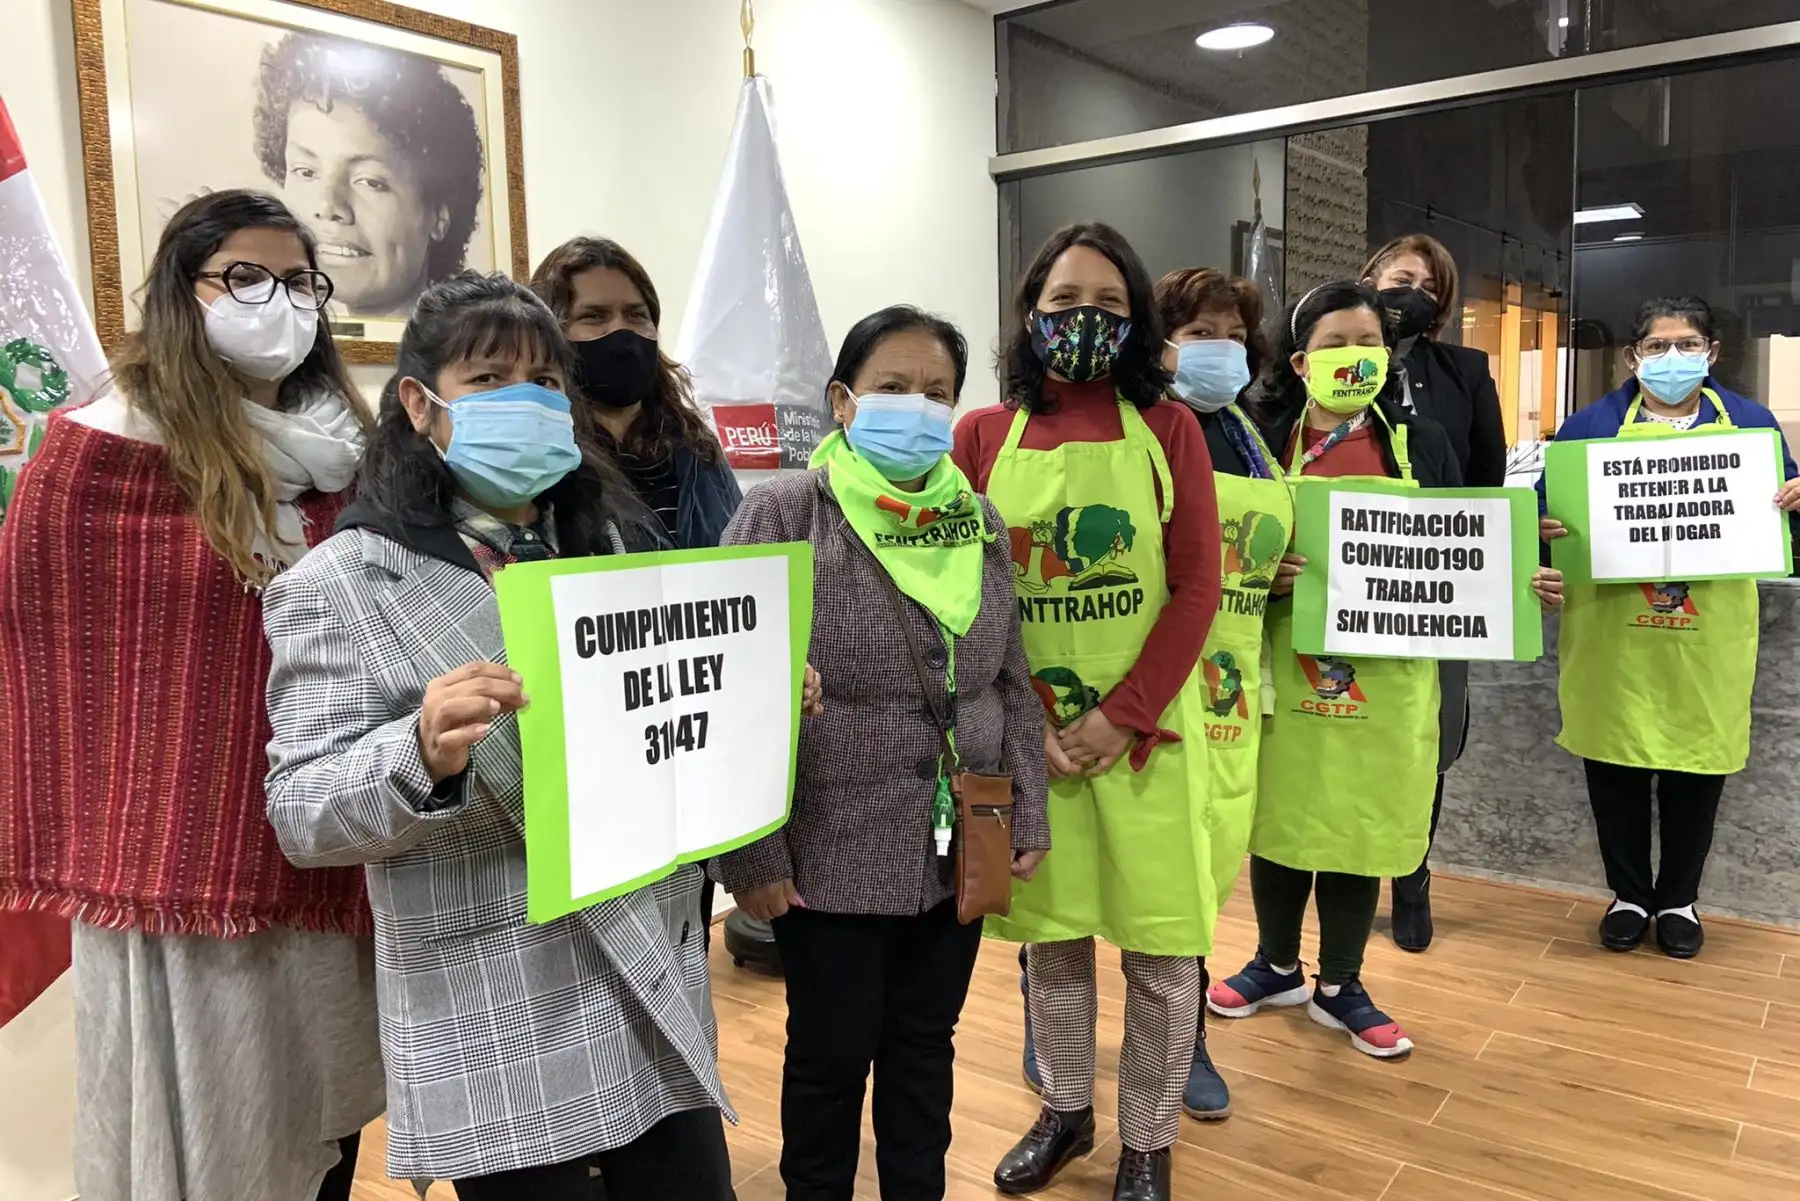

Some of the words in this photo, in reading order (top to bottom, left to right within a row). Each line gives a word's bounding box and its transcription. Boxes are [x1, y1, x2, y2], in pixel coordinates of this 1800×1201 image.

[725, 421, 772, 447] PERÚ
[787, 427, 800, 443] de
[801, 428, 811, 443] la
[788, 446, 812, 462] Pob
[1603, 457, 1643, 476] ESTÁ
[1647, 453, 1740, 475] PROHIBIDO
[1693, 479, 1705, 494] A
[1708, 476, 1728, 493] LA
[1614, 499, 1735, 521] TRABAJADORA
[1341, 508, 1485, 538] RATIFICACIÓN
[1629, 526, 1658, 543] DEL
[1661, 523, 1721, 542] HOGAR
[1341, 541, 1484, 571] CONVENIO190
[1365, 577, 1454, 605] TRABAJO
[1017, 587, 1144, 623] NTTRAHOP
[574, 595, 757, 660] CUMPLIMIENTO
[1336, 609, 1369, 634] SIN
[1373, 611, 1488, 639] VIOLENCIA
[1635, 614, 1692, 627] CGTP
[623, 666, 654, 712] DE
[677, 653, 724, 697] LEY
[1299, 699, 1359, 715] CGTP
